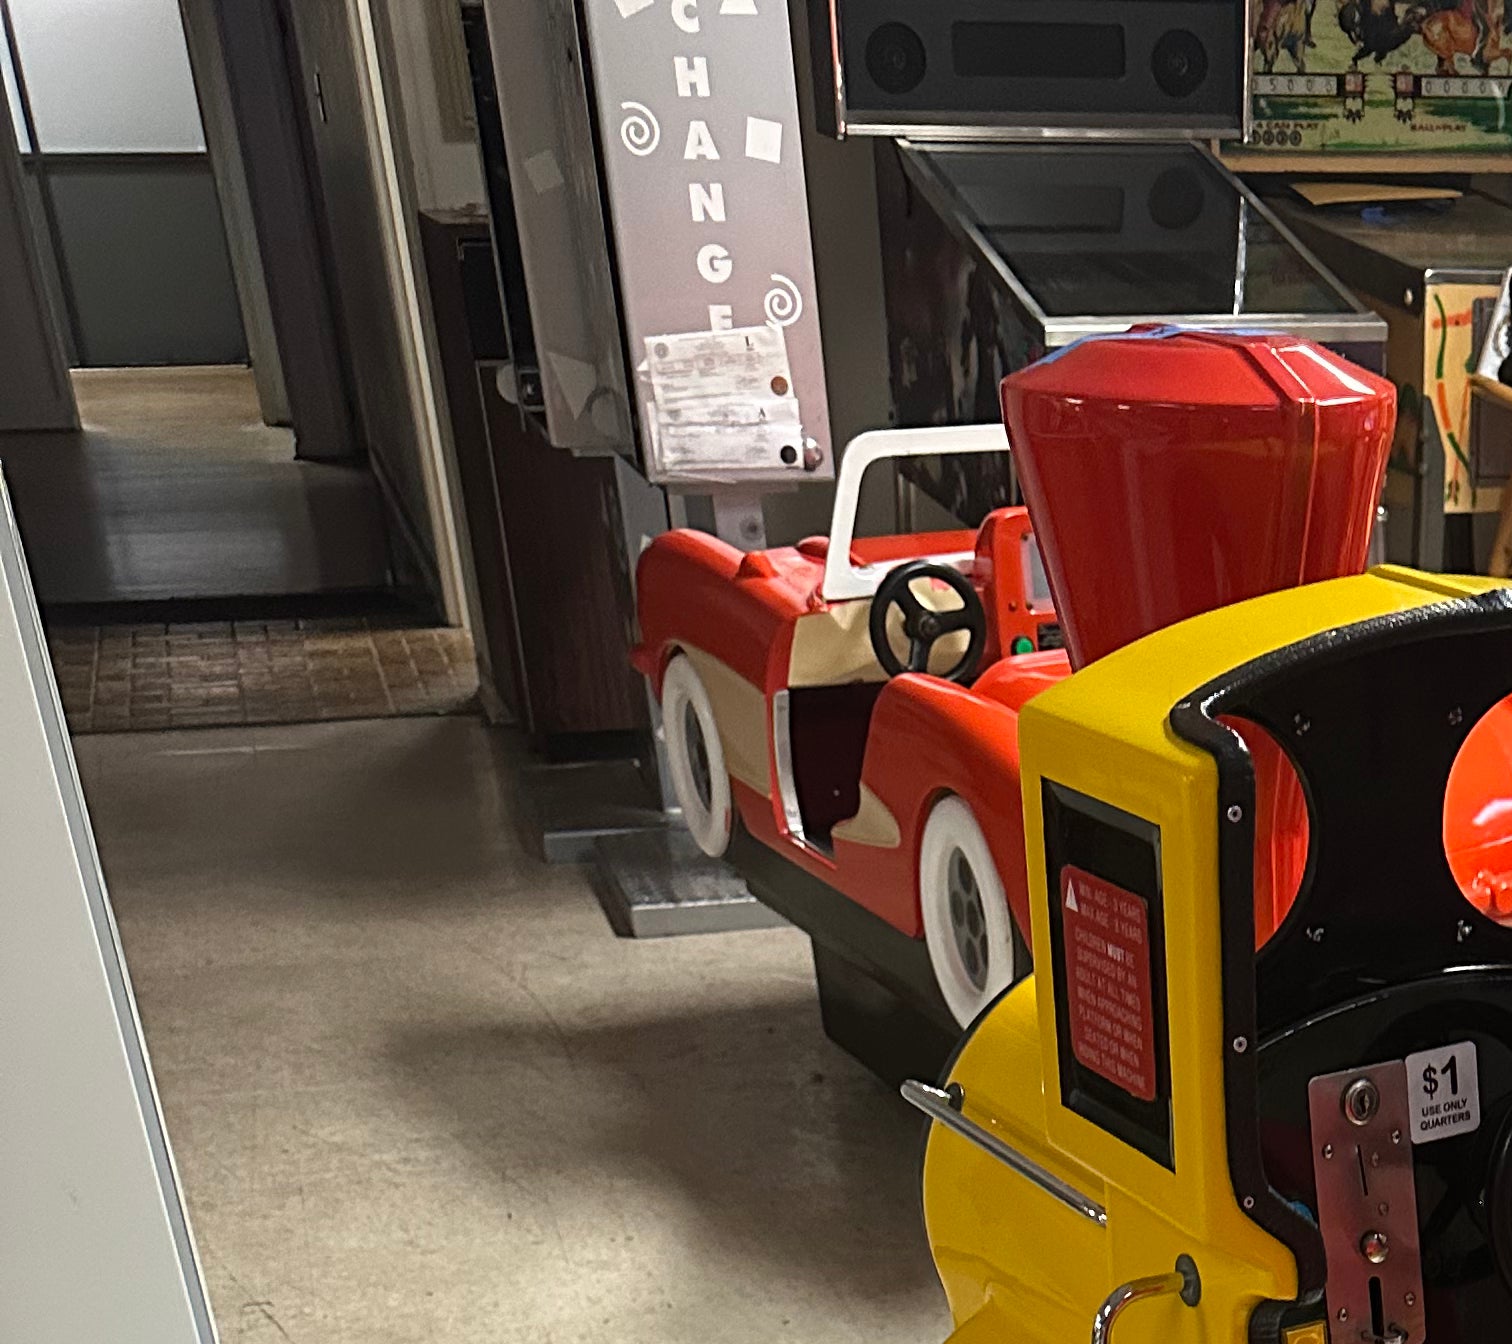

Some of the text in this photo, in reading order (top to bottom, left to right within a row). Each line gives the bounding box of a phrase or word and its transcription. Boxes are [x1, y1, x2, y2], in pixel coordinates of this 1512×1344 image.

[671, 0, 734, 331] CHANGE
[1422, 1055, 1459, 1100] $1
[1420, 1111, 1471, 1131] QUARTERS
[1421, 1098, 1468, 1118] USE ONLY
